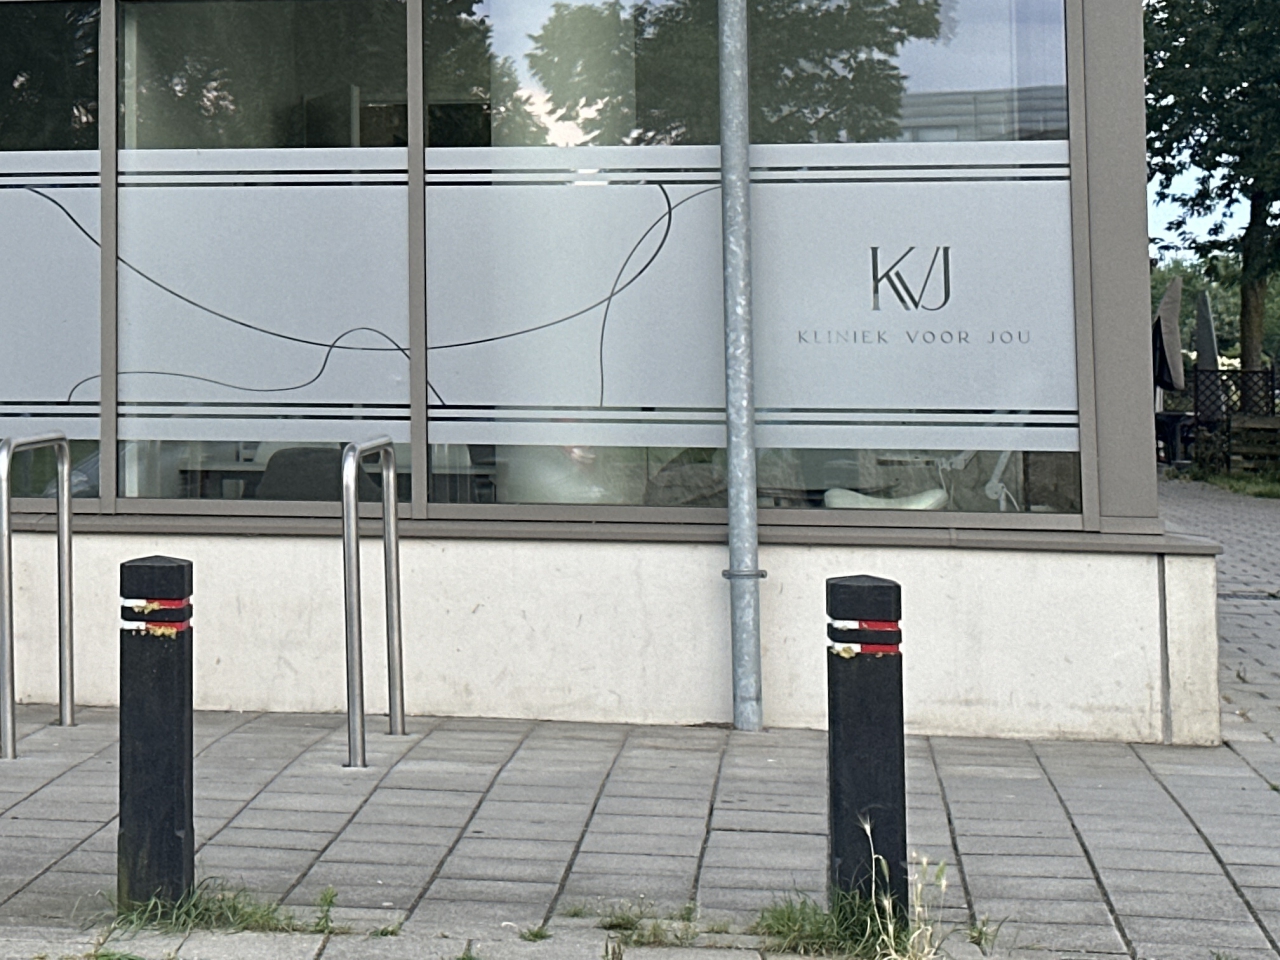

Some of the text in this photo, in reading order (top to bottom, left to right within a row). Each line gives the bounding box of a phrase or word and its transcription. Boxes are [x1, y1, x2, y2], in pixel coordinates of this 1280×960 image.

[870, 246, 951, 311] KVJ
[798, 330, 1032, 344] KLINIEK VOOR JOU
